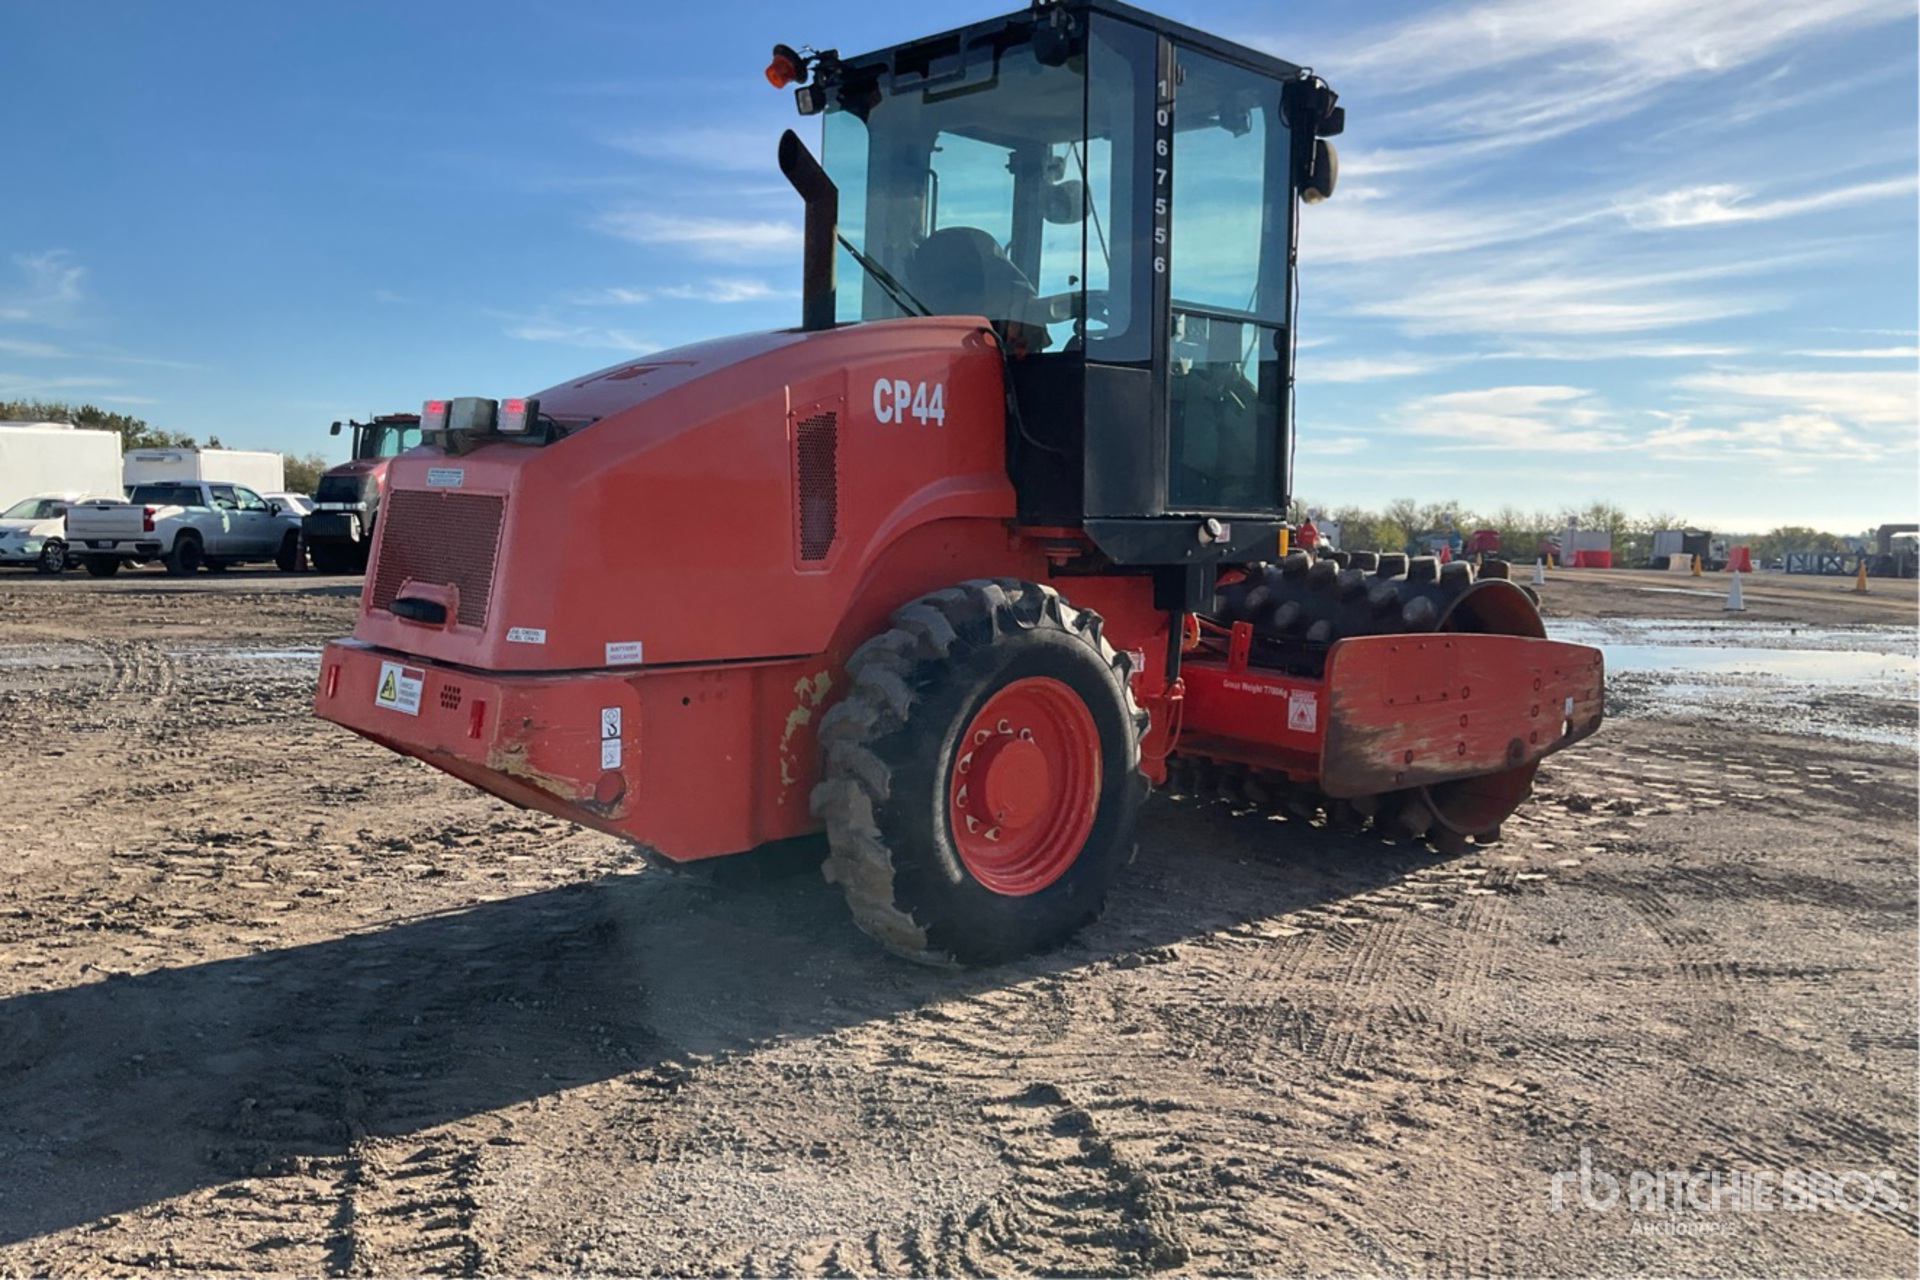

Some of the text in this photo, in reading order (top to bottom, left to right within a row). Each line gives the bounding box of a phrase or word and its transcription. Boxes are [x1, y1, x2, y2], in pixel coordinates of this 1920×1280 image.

[1154, 80, 1169, 273] 1067556
[873, 378, 945, 426] CP44
[1242, 682, 1263, 694] Weight
